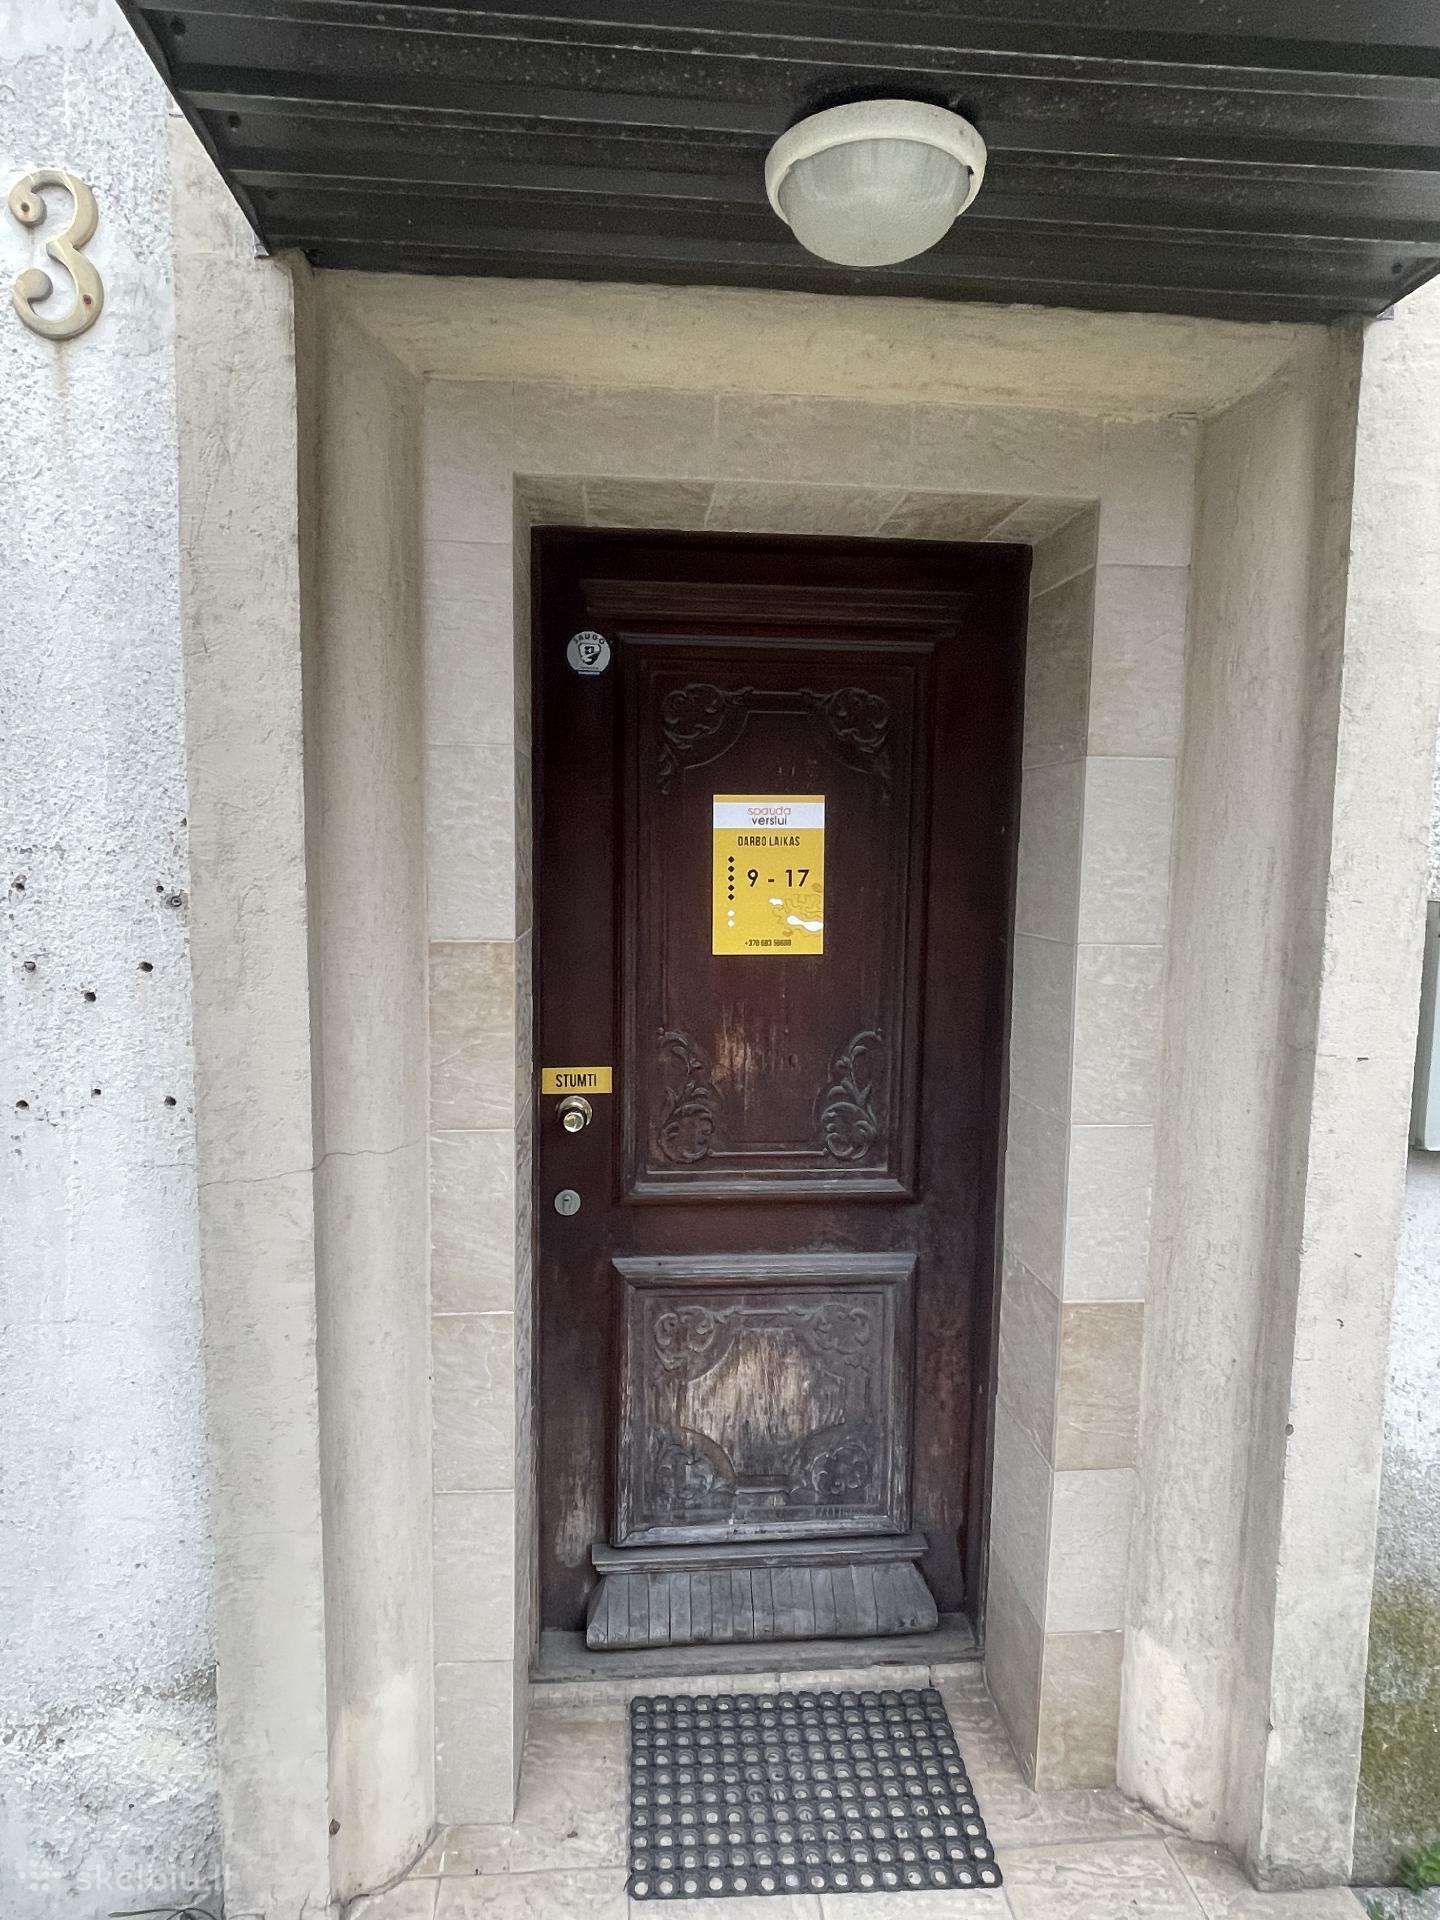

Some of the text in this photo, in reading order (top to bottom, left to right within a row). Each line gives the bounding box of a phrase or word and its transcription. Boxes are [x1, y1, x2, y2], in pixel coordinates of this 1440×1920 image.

[8, 168, 105, 341] 3
[747, 806, 791, 816] spauda
[752, 815, 787, 826] verslui
[737, 836, 800, 847] DARBO LAIKAS
[747, 868, 759, 888] 9
[785, 868, 810, 887] 17
[555, 1073, 597, 1088] STUMTI
